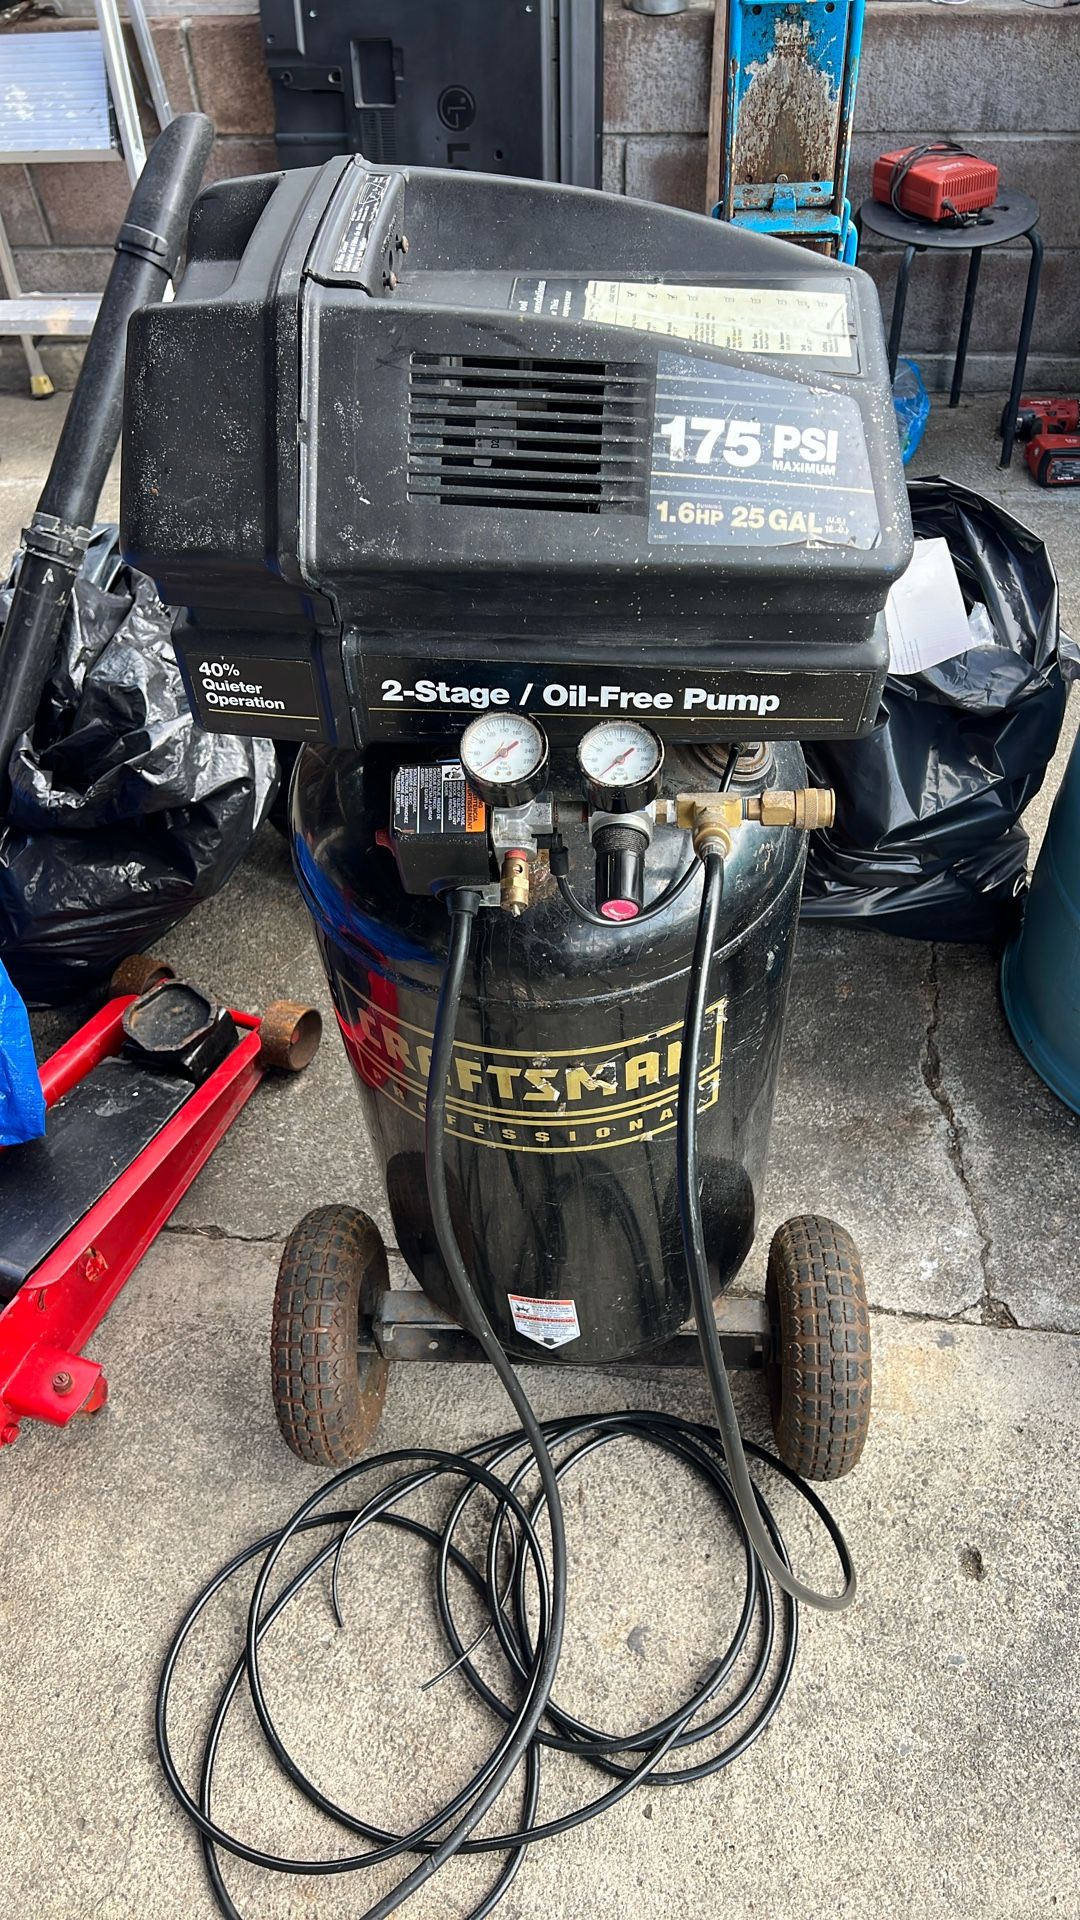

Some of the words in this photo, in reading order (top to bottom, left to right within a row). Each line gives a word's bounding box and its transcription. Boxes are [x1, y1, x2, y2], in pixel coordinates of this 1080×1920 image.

[562, 290, 572, 317] ompressor
[661, 416, 761, 467] 175
[773, 425, 839, 463] PSI
[772, 459, 836, 476] MAXIMUM
[730, 506, 765, 529] 25
[769, 509, 823, 534] GAL
[199, 662, 240, 677] 40%
[202, 678, 263, 695] Quieter
[381, 680, 510, 708] 2-Stage
[519, 683, 534, 705] /
[542, 684, 673, 710] Oil-Free
[683, 688, 780, 716] Pump
[205, 692, 285, 710] Operation
[373, 1070, 673, 1143] PROFESSIONA
